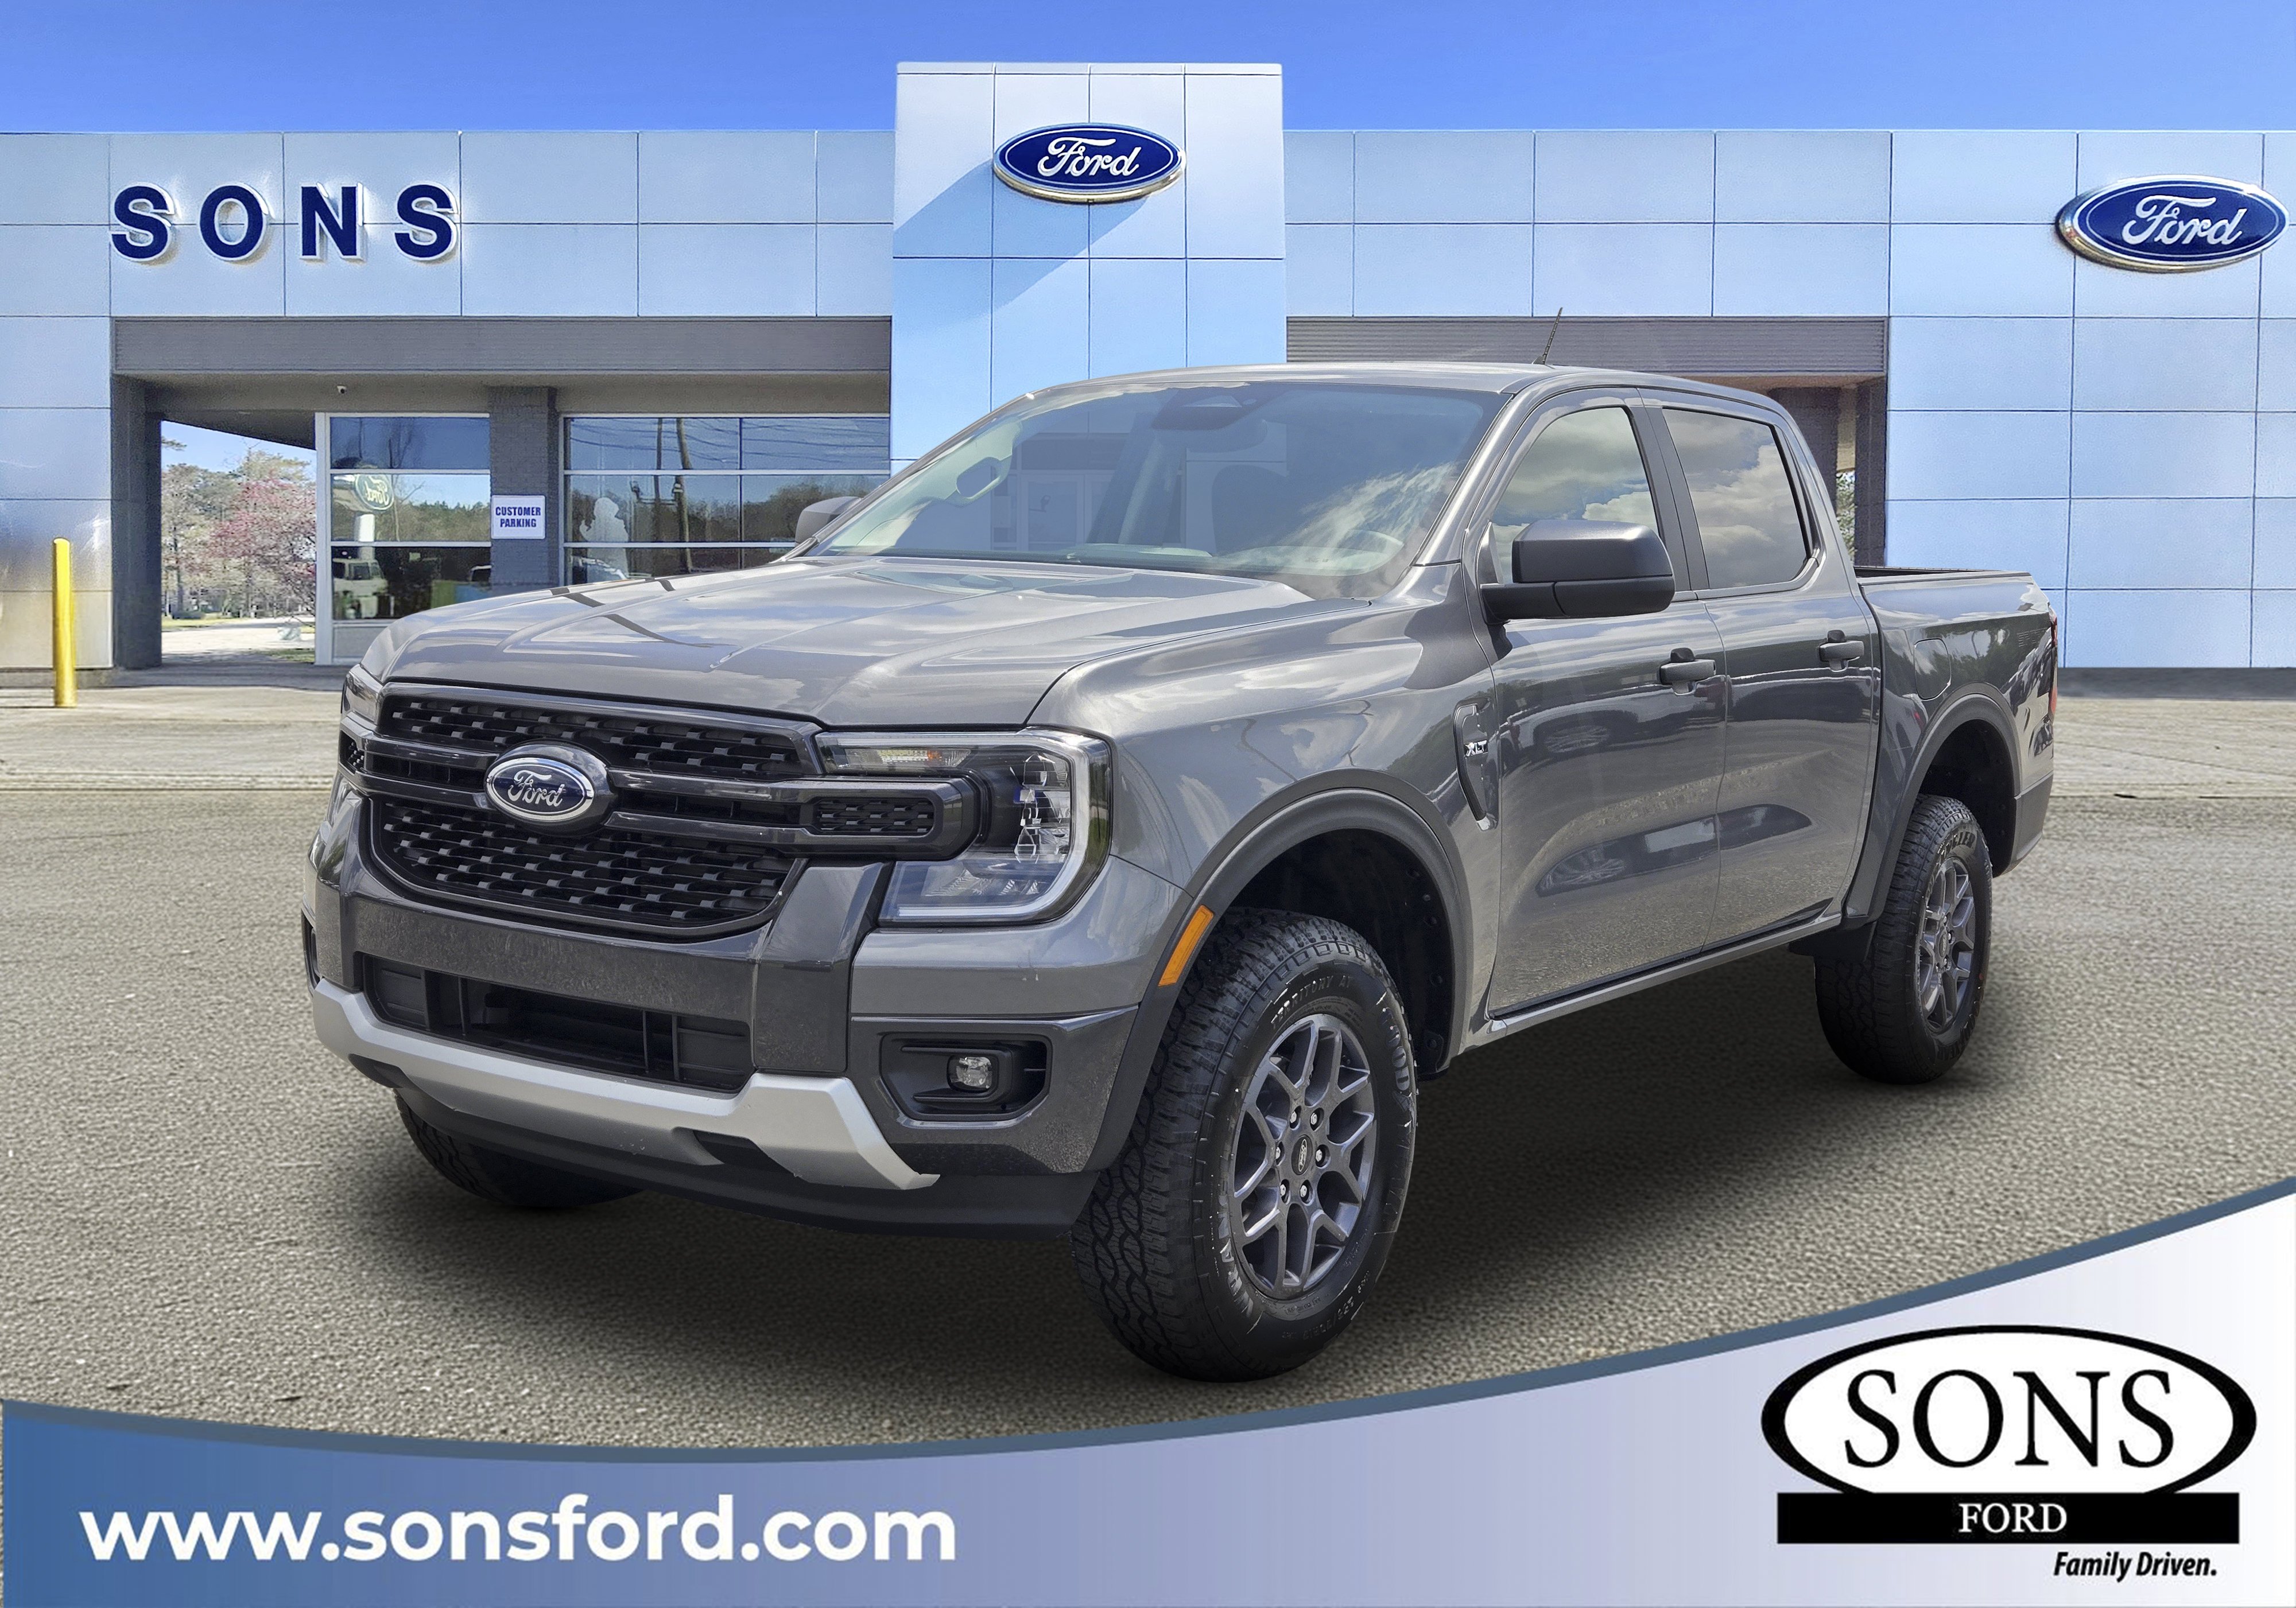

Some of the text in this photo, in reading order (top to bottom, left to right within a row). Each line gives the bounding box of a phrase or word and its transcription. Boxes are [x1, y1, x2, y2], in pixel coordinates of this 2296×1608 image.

[1037, 137, 1142, 177] Ford
[111, 184, 455, 261] SONS
[2122, 195, 2248, 245] Ford
[495, 507, 541, 516] CUSTOMER
[500, 519, 537, 527] PARKING
[507, 770, 565, 807] Ford
[1271, 976, 1333, 1030] TERRITORY
